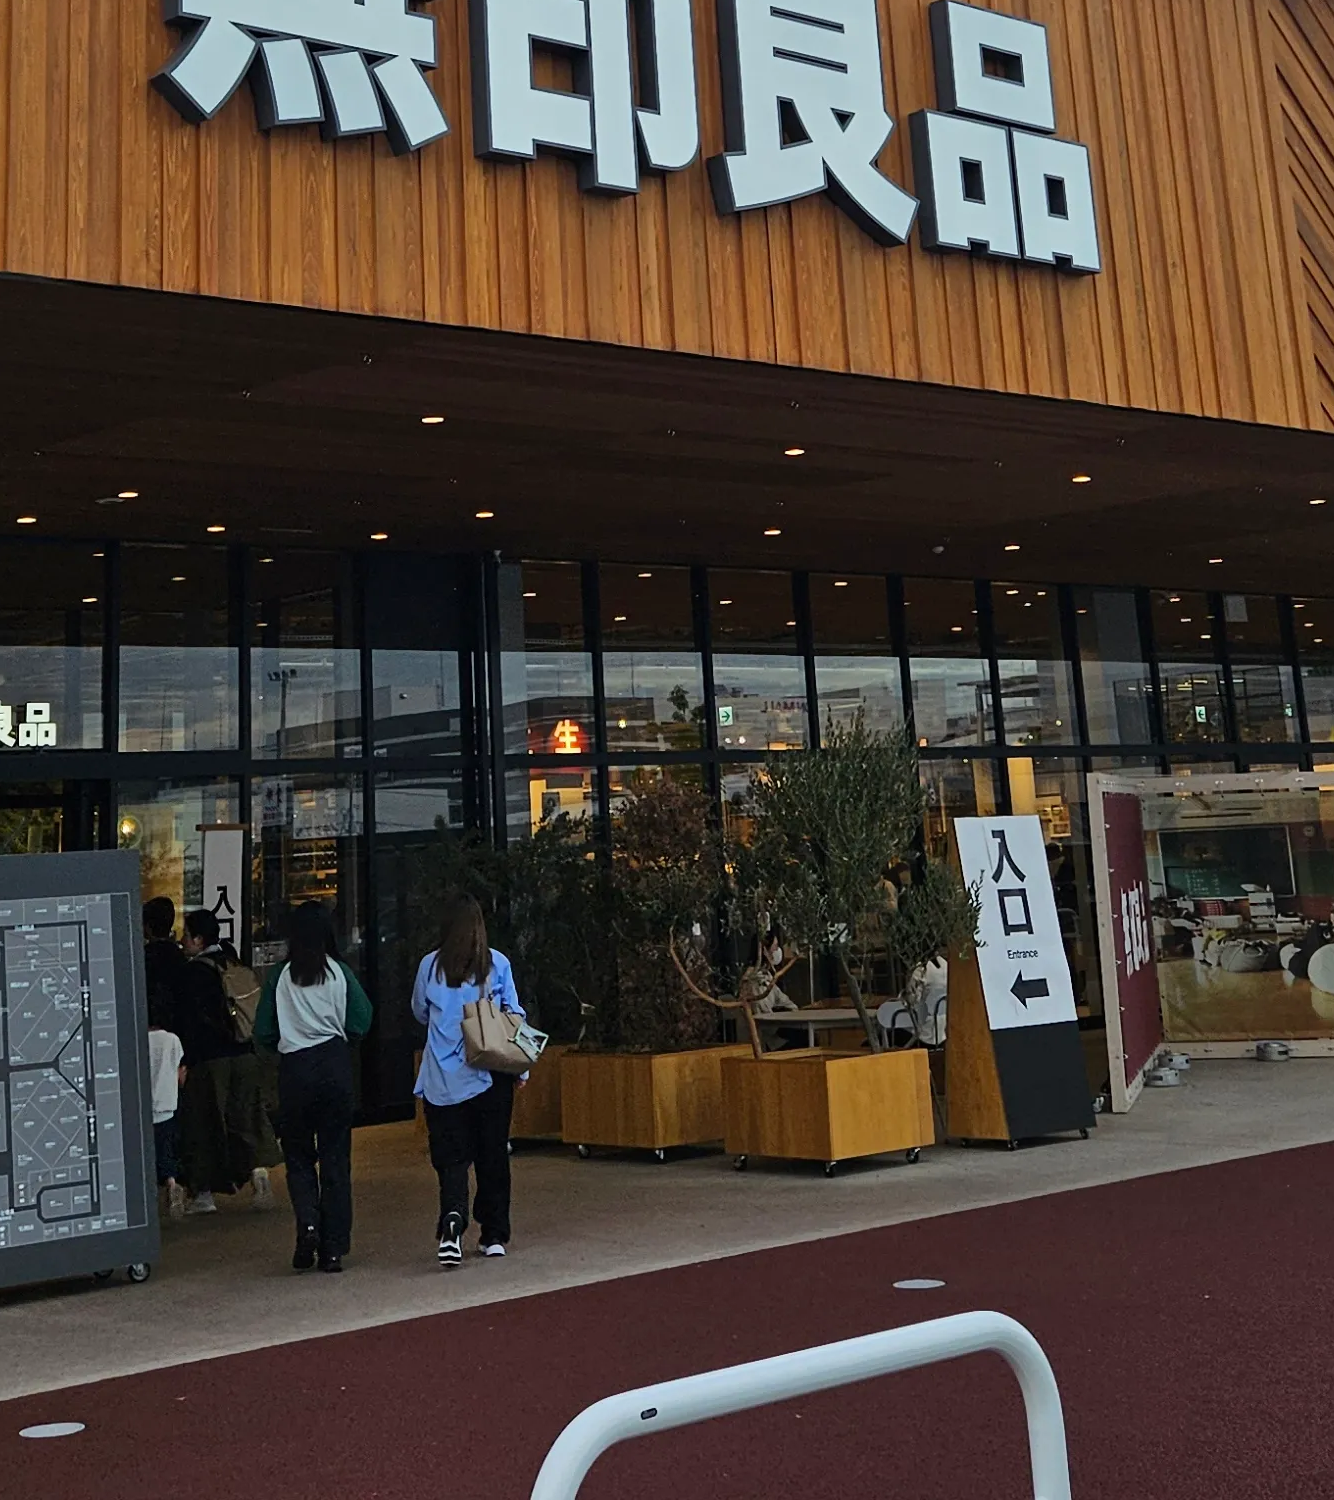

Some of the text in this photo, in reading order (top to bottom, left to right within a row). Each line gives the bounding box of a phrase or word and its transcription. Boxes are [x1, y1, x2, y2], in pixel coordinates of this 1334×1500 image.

[553, 719, 582, 754] 生
[991, 829, 1035, 936] 入口
[1007, 949, 1039, 960] Entrance
